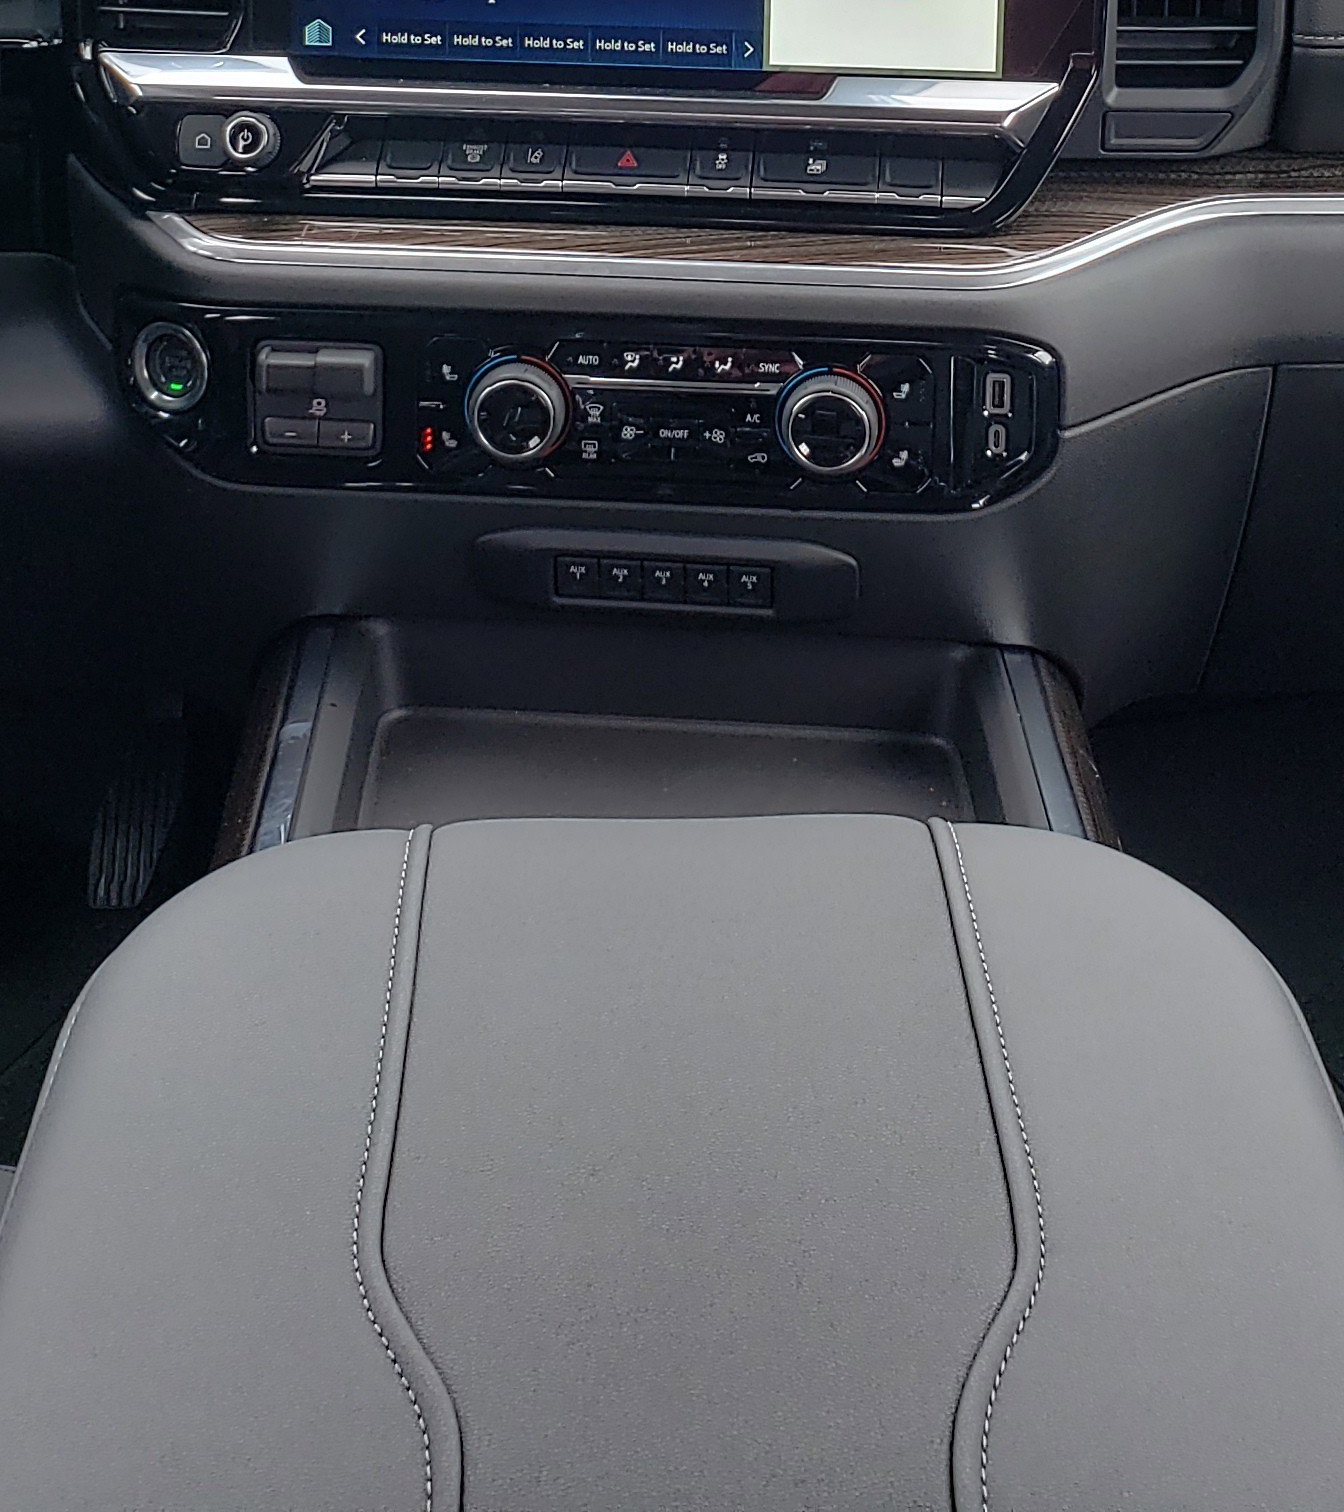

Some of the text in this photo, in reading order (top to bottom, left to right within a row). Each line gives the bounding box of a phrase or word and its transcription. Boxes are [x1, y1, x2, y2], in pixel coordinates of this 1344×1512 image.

[382, 33, 442, 45] Hold to Set
[454, 35, 513, 47] Hold to Set
[525, 37, 584, 50] Hold to Set
[596, 40, 655, 52] Hold to Set
[668, 42, 728, 54] Hold to Set
[578, 356, 599, 365] AUTO
[758, 363, 780, 374] SYNC
[746, 414, 760, 422] A/C
[659, 430, 689, 438] ON/OFF
[613, 568, 628, 576] AUX
[655, 570, 671, 578] AUX
[741, 575, 757, 583] AUX
